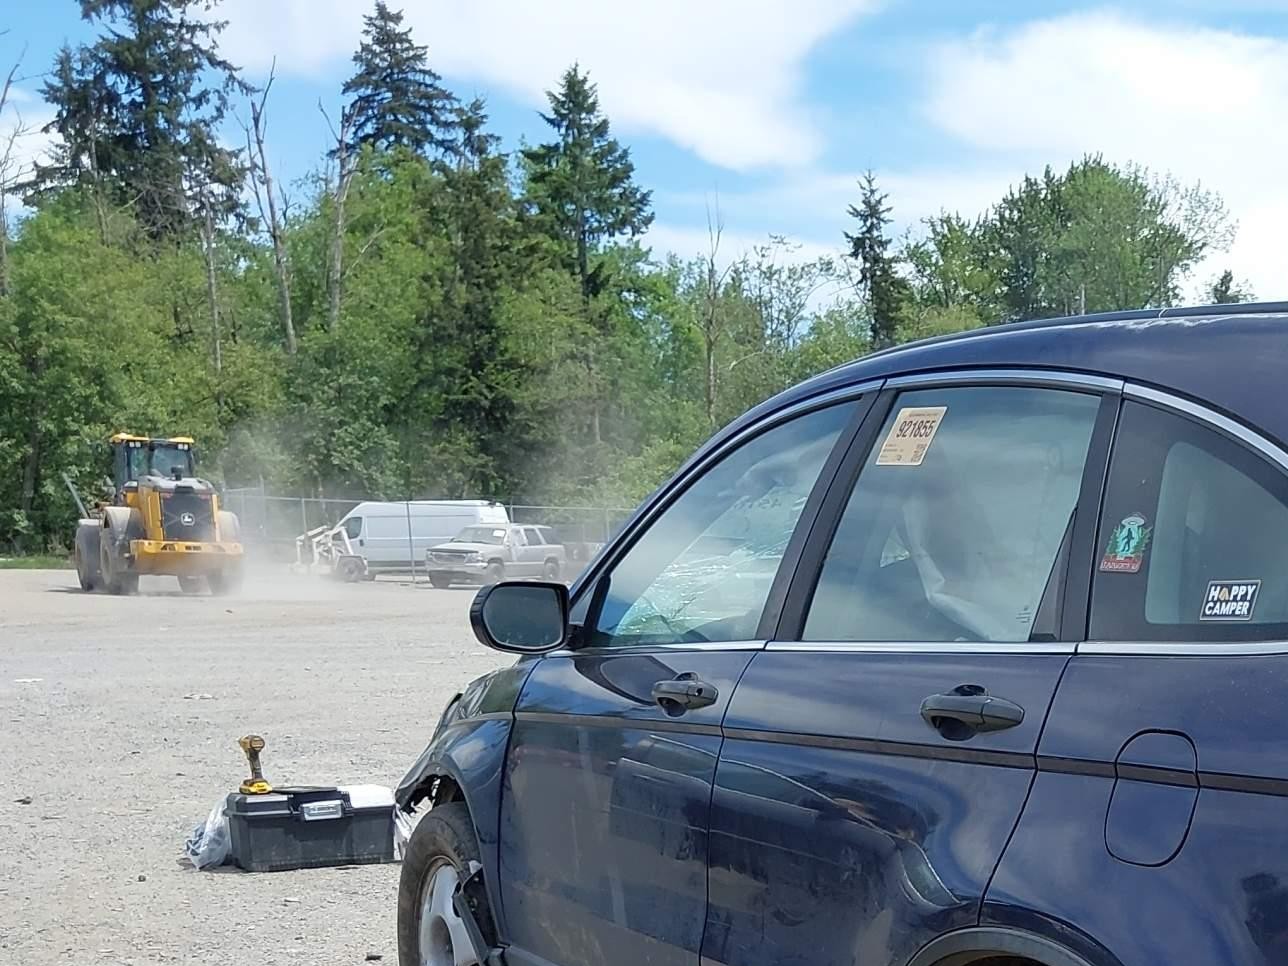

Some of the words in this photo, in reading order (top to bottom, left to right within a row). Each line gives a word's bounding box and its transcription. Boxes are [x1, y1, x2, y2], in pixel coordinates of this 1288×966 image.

[896, 420, 937, 438] 921855
[1208, 585, 1256, 601] HAPPY
[1204, 602, 1250, 616] CAMPER
